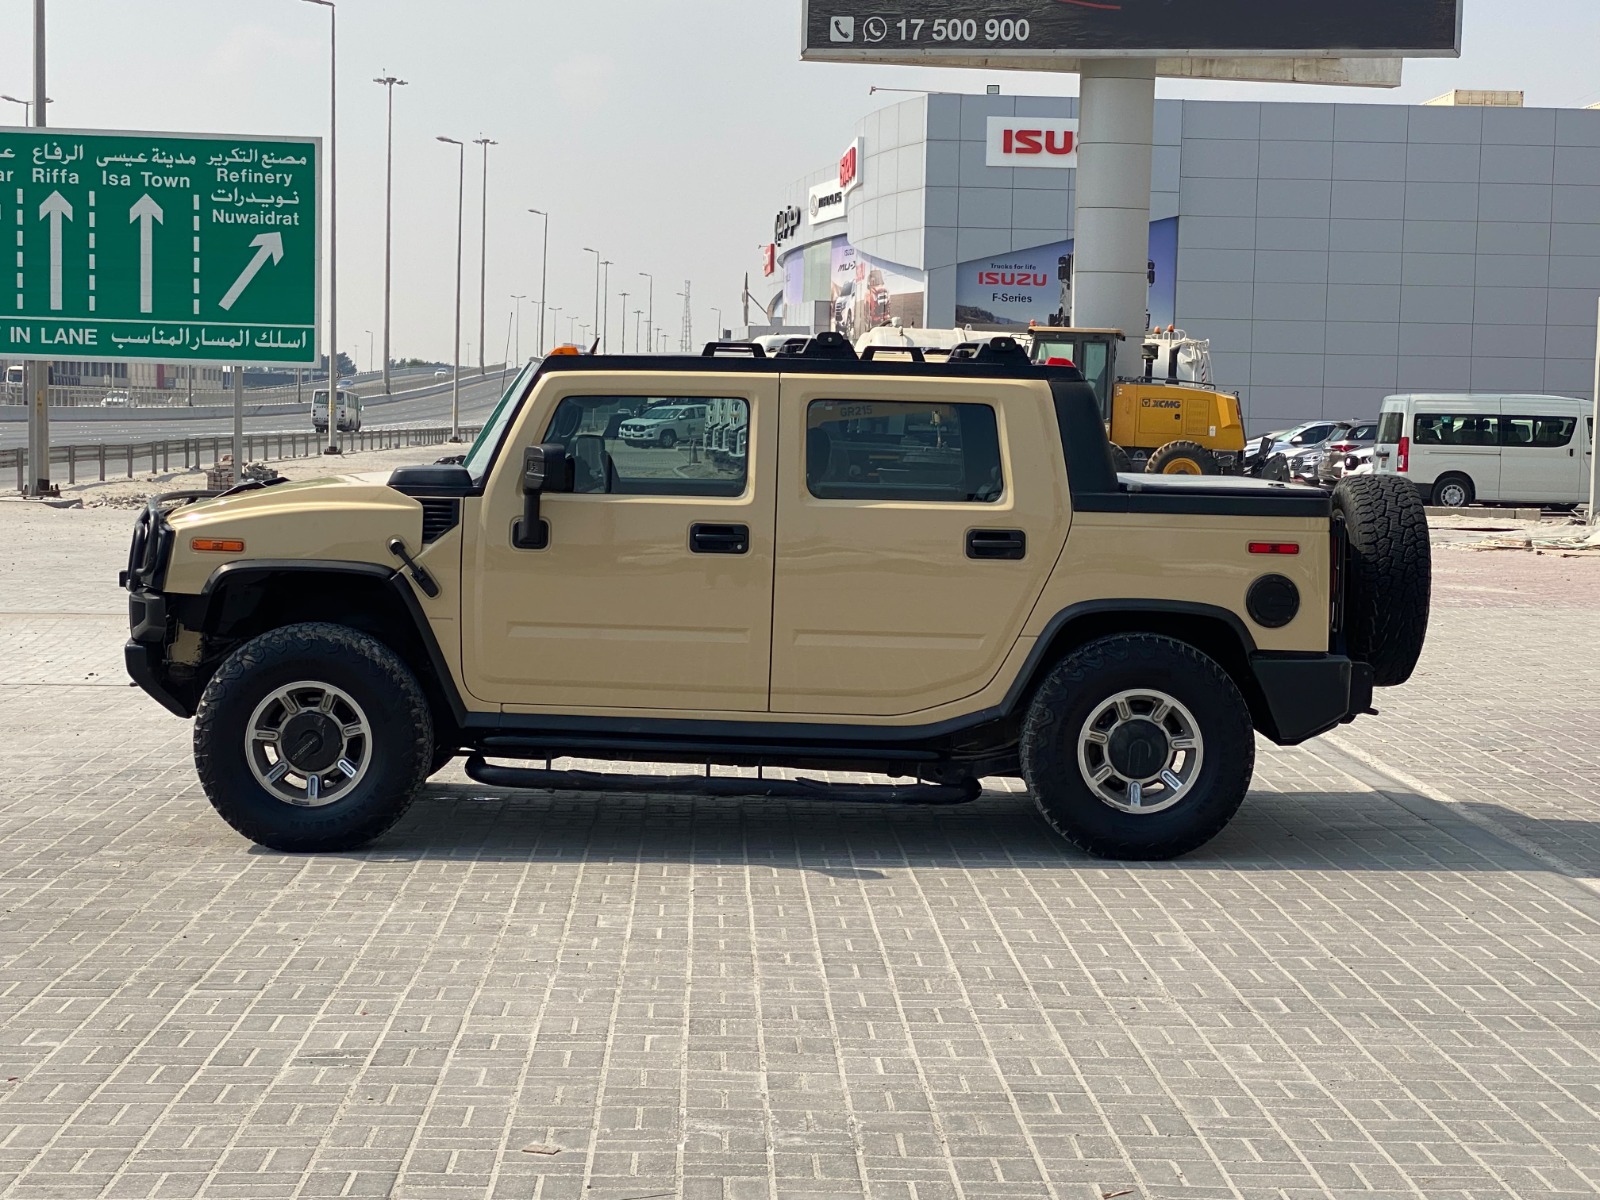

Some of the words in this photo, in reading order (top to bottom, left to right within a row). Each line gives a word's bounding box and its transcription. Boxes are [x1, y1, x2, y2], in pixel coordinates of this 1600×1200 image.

[896, 18, 925, 41] 17
[931, 18, 977, 41] 500
[984, 18, 1030, 41] 900
[1003, 129, 1078, 155] ISU
[32, 142, 84, 165] الرفاع
[96, 152, 148, 167] عيسى
[151, 147, 196, 168] مدينة
[206, 147, 258, 167] التكرير
[261, 152, 307, 169] مصنع
[32, 167, 79, 184] Riffa
[102, 170, 131, 186] Isa
[140, 171, 190, 188] Town
[216, 168, 293, 187] Refinery
[210, 187, 299, 208] نويدرات
[212, 209, 299, 226] Nuwaidrat
[990, 263, 1013, 271] Trucks
[978, 272, 1047, 286] ISUZU
[992, 293, 1032, 303] F-Series
[10, 326, 31, 343] IN
[40, 327, 98, 345] LANE
[111, 326, 189, 349] المناسب
[190, 327, 250, 350] المسار
[254, 330, 307, 348] اسلك
[840, 405, 872, 417] GR215
[1151, 400, 1181, 408] XCMG
